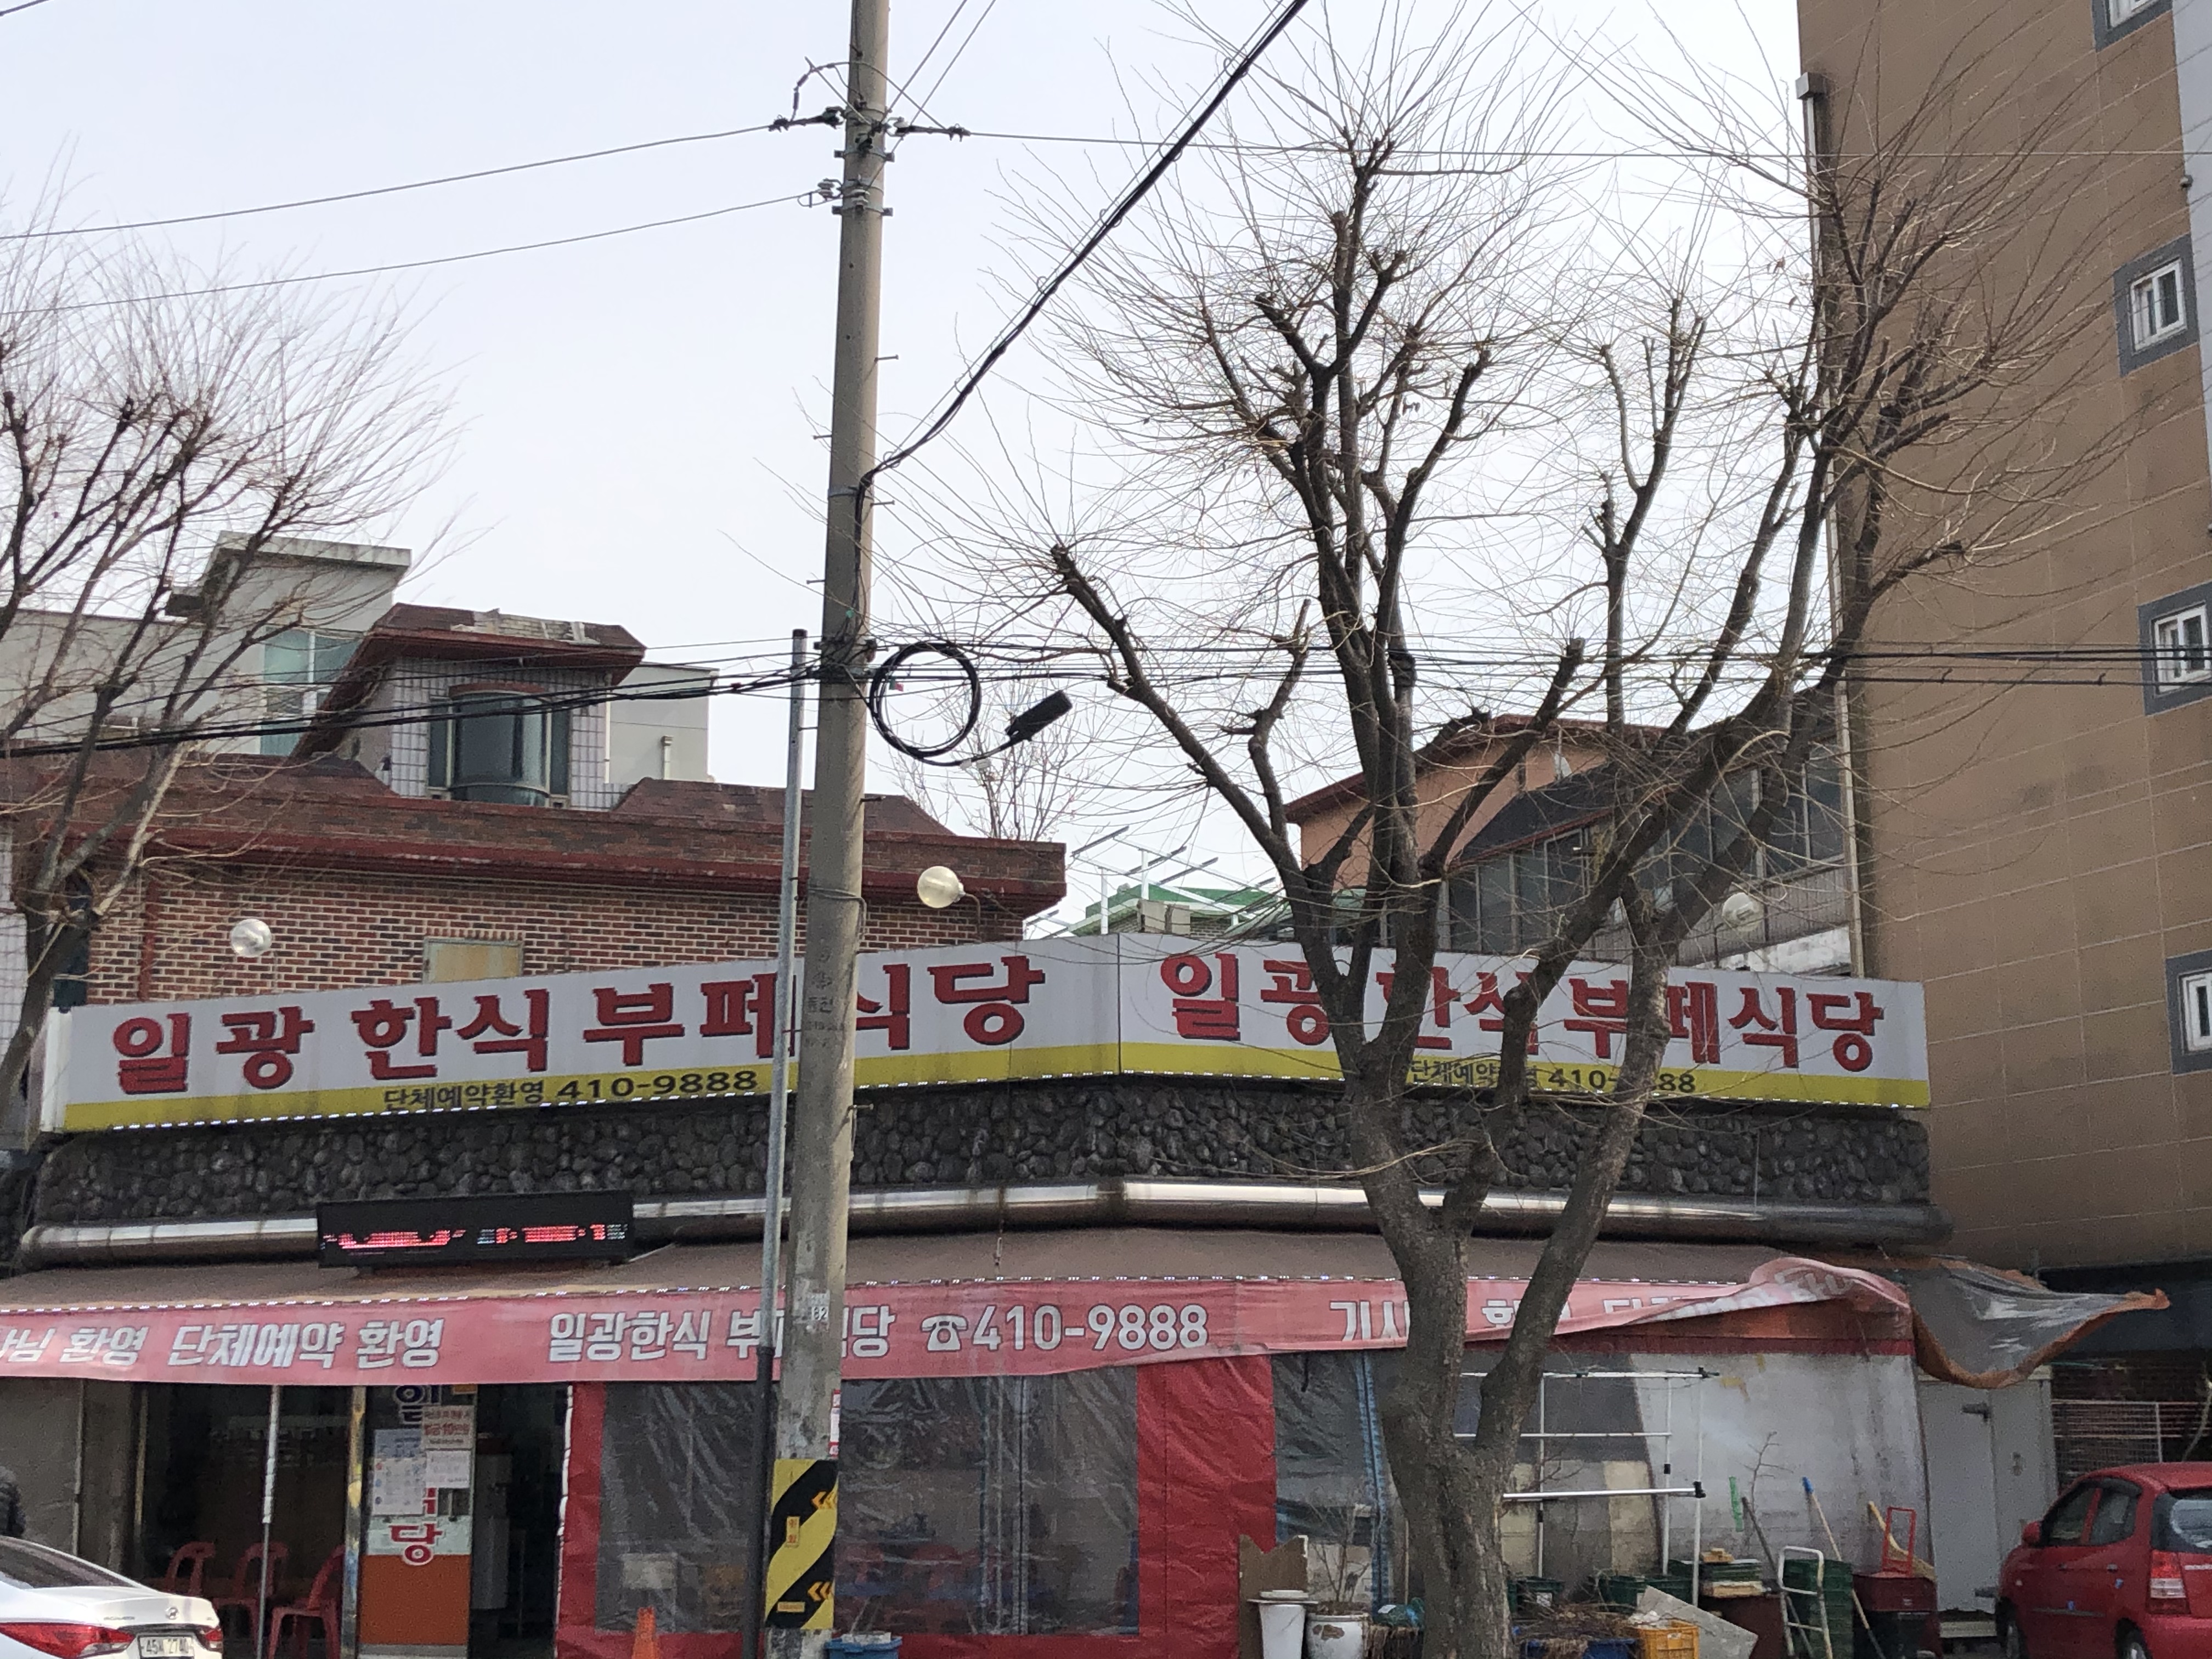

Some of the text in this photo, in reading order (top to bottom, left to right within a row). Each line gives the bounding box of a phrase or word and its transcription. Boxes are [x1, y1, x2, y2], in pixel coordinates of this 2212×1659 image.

[114, 1006, 314, 1094] 일광
[351, 989, 549, 1080] 한식
[384, 1070, 757, 1111] 단체예약환영 410-9888
[1548, 1068, 1696, 1093] 410-88
[59, 1327, 149, 1366] 환영
[168, 1319, 443, 1369] 단체예약 환영
[550, 1309, 712, 1363] 일광한식
[972, 1304, 1208, 1351] 410-9888
